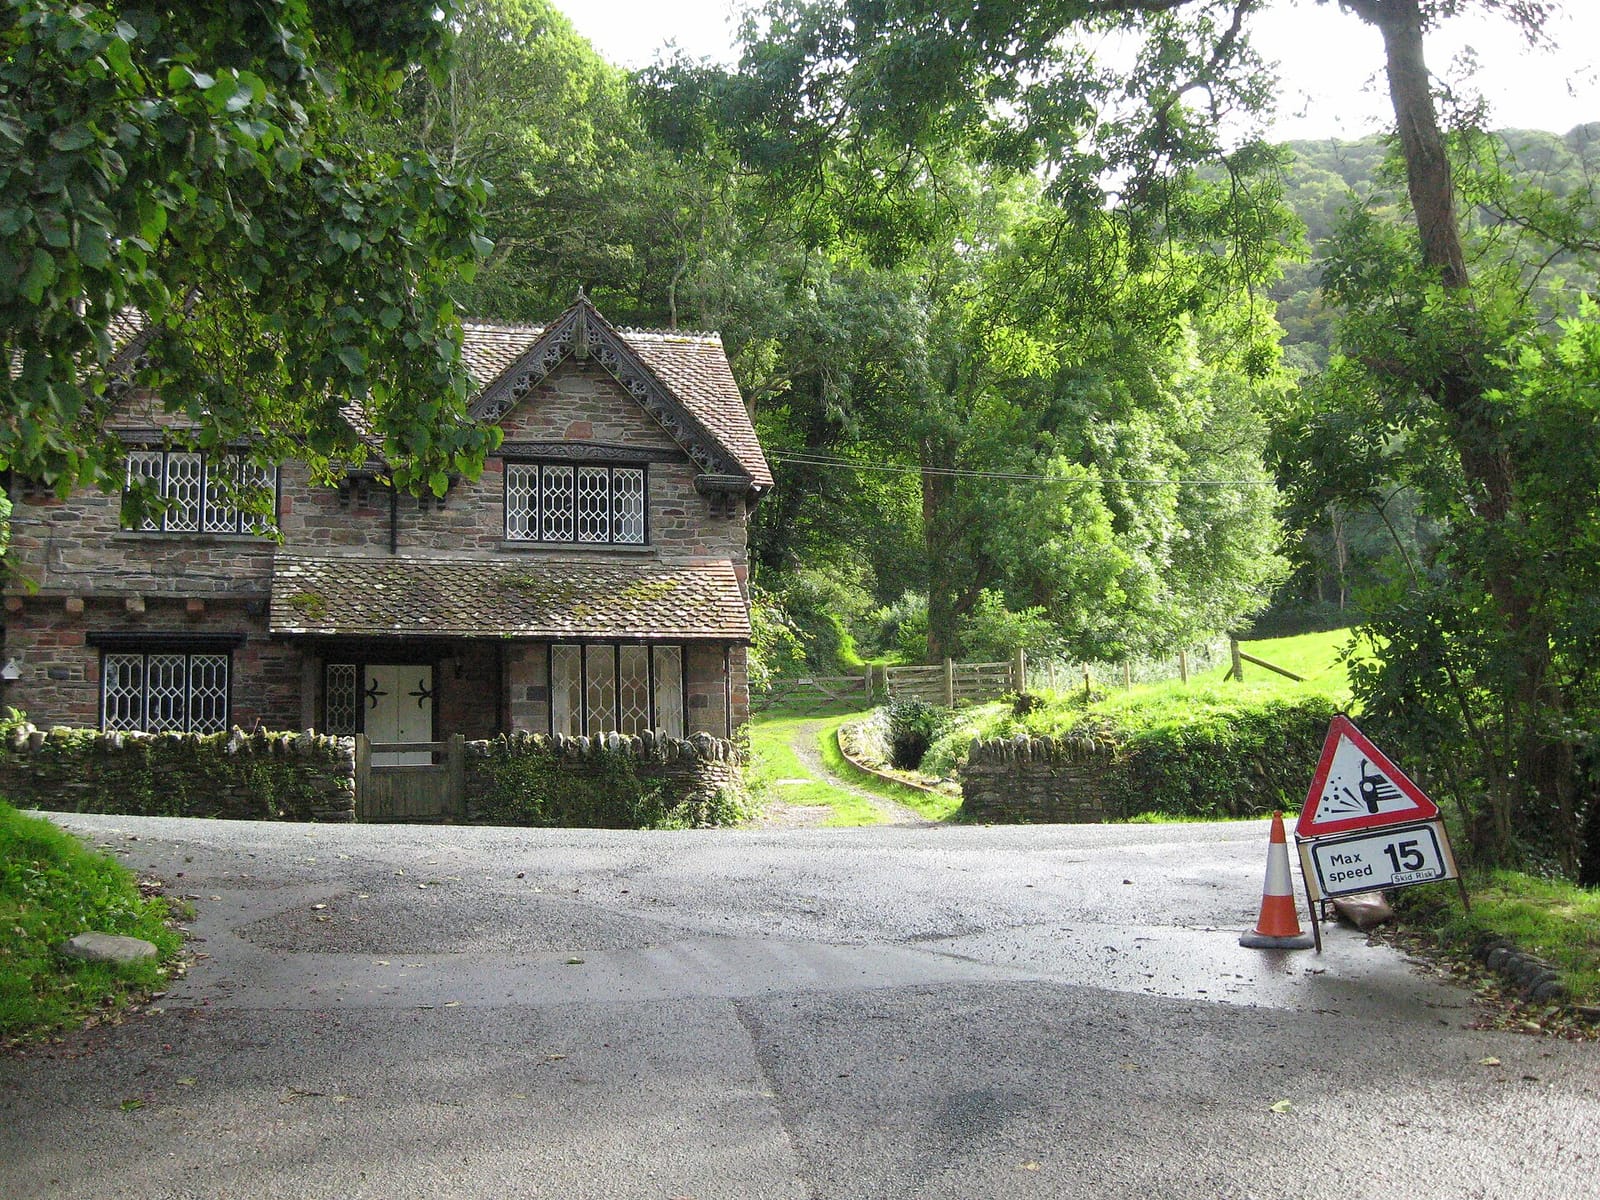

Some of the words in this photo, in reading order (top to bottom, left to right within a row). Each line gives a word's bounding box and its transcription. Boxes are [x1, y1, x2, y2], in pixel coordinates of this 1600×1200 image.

[1330, 853, 1362, 866] Max
[1384, 840, 1425, 873] 15
[1329, 864, 1373, 883] speed
[1394, 873, 1413, 882] Skid
[1415, 870, 1433, 881] Risk
